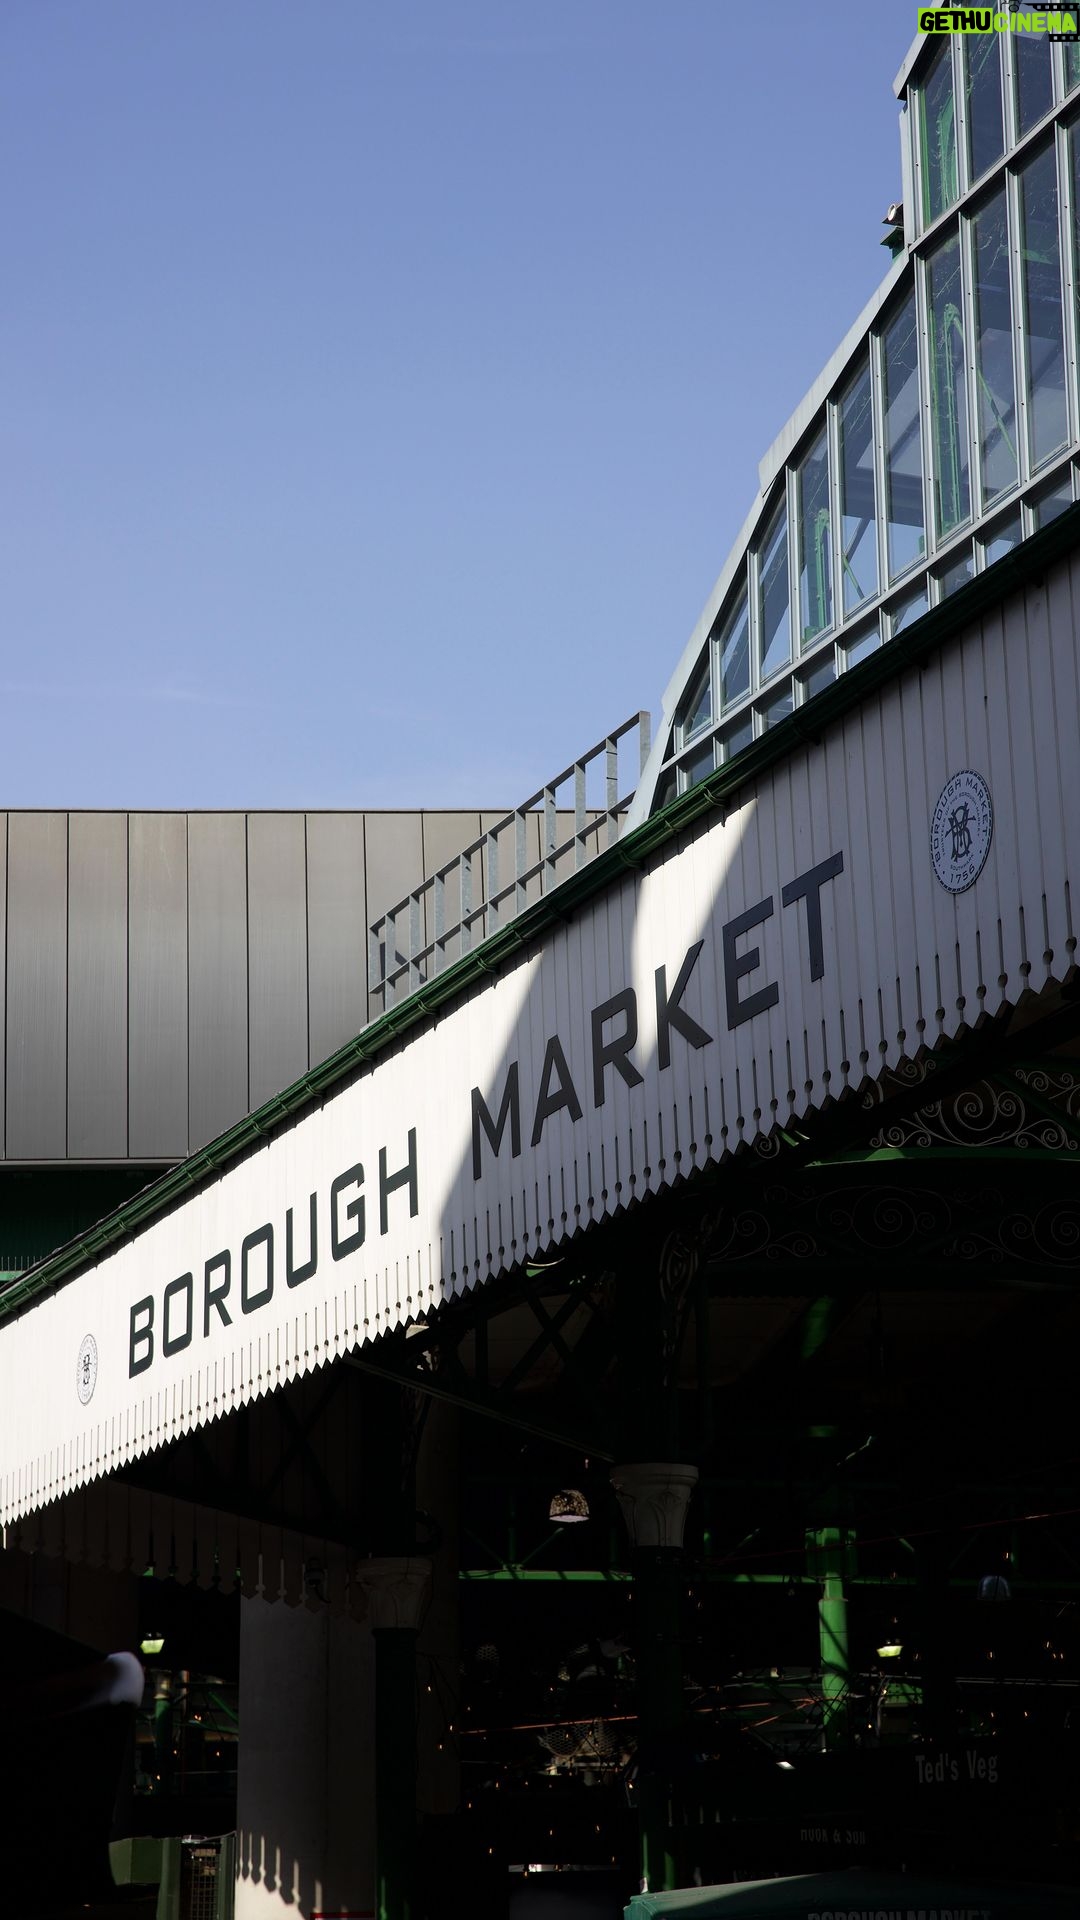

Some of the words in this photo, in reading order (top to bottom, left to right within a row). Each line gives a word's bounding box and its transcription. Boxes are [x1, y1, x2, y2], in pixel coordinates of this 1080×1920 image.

[933, 778, 962, 862] BOROUGH
[966, 777, 988, 836] MARKET
[950, 864, 975, 884] 1756
[129, 1127, 420, 1379] BOROUGH
[470, 851, 844, 1180] MARKET
[915, 1752, 959, 1784] Ted's
[966, 1749, 999, 1784] Veg
